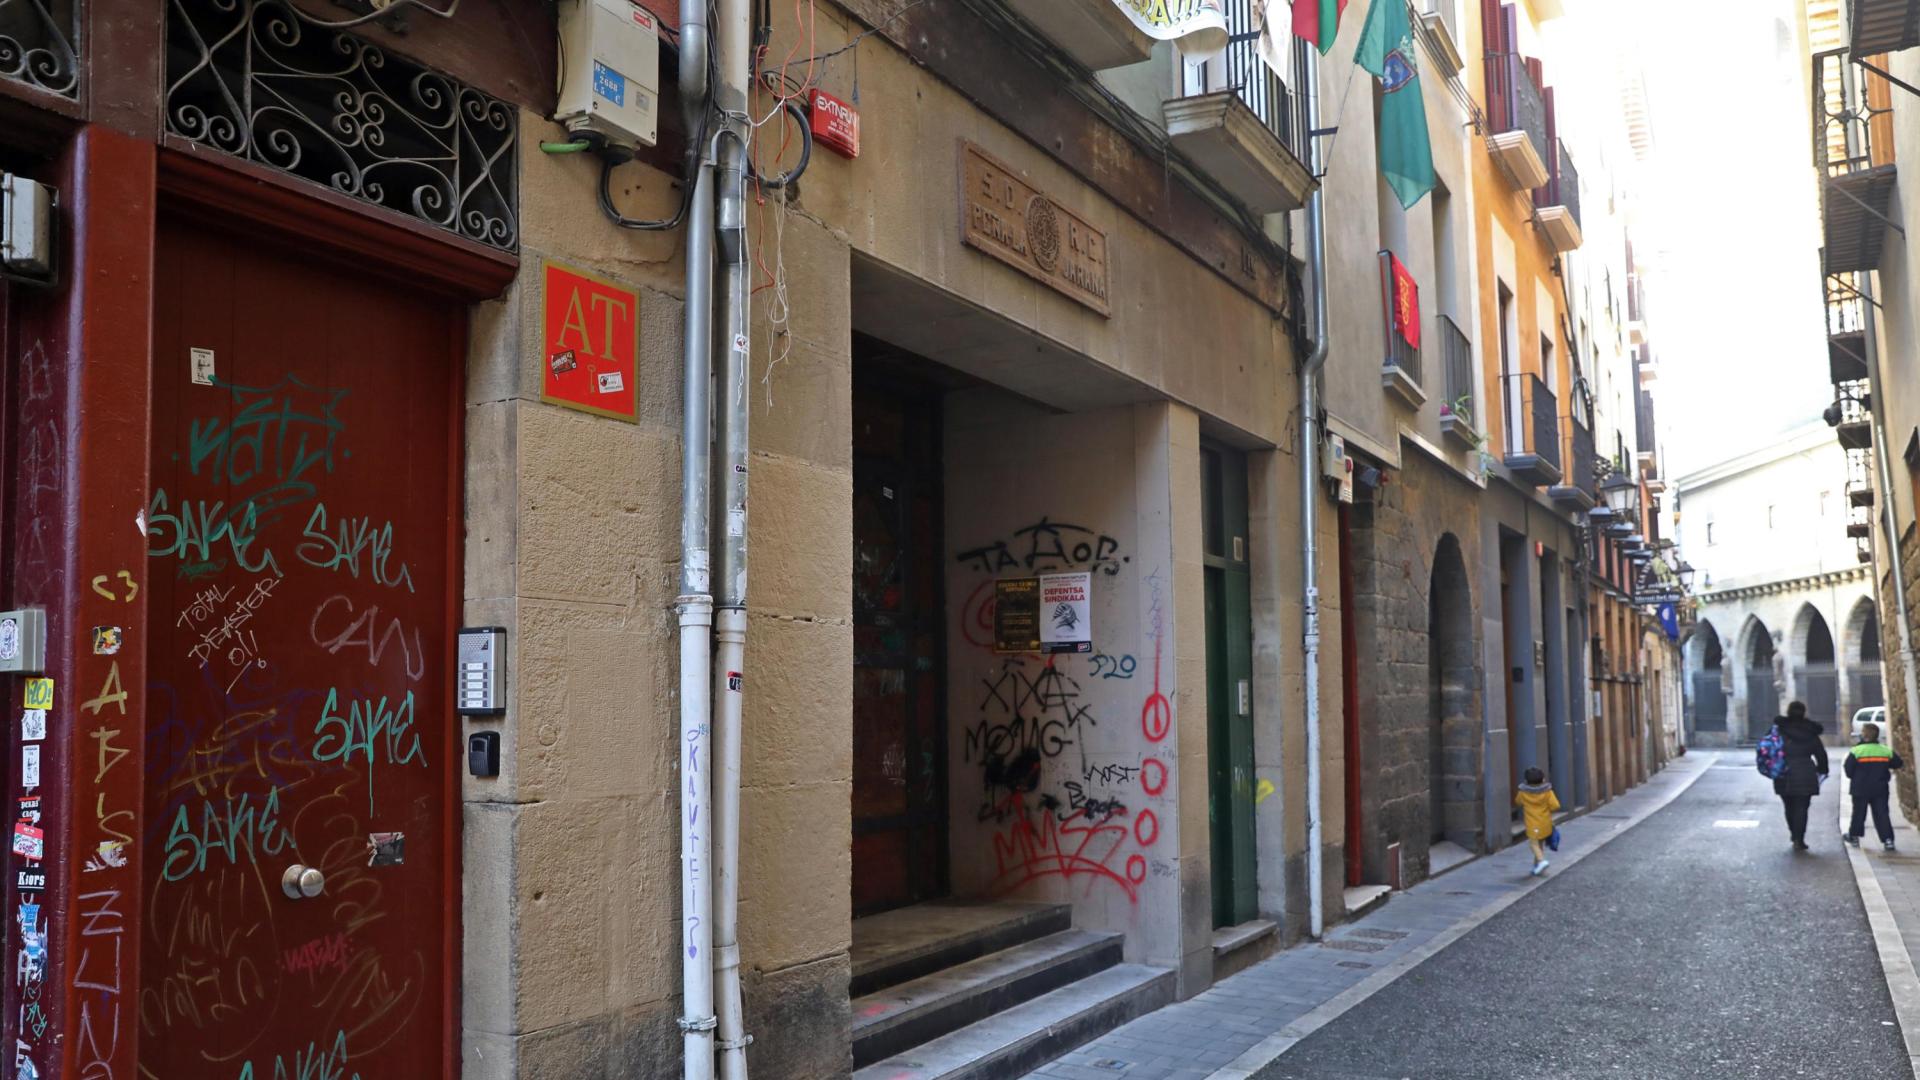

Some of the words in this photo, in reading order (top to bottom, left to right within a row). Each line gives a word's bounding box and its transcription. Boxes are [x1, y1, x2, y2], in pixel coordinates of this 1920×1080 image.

[556, 286, 627, 362] AT
[1044, 586, 1084, 595] DEFENTSA
[1044, 594, 1085, 603] SINDIKALA
[311, 687, 427, 769] SAKE
[163, 785, 297, 881] SAKE
